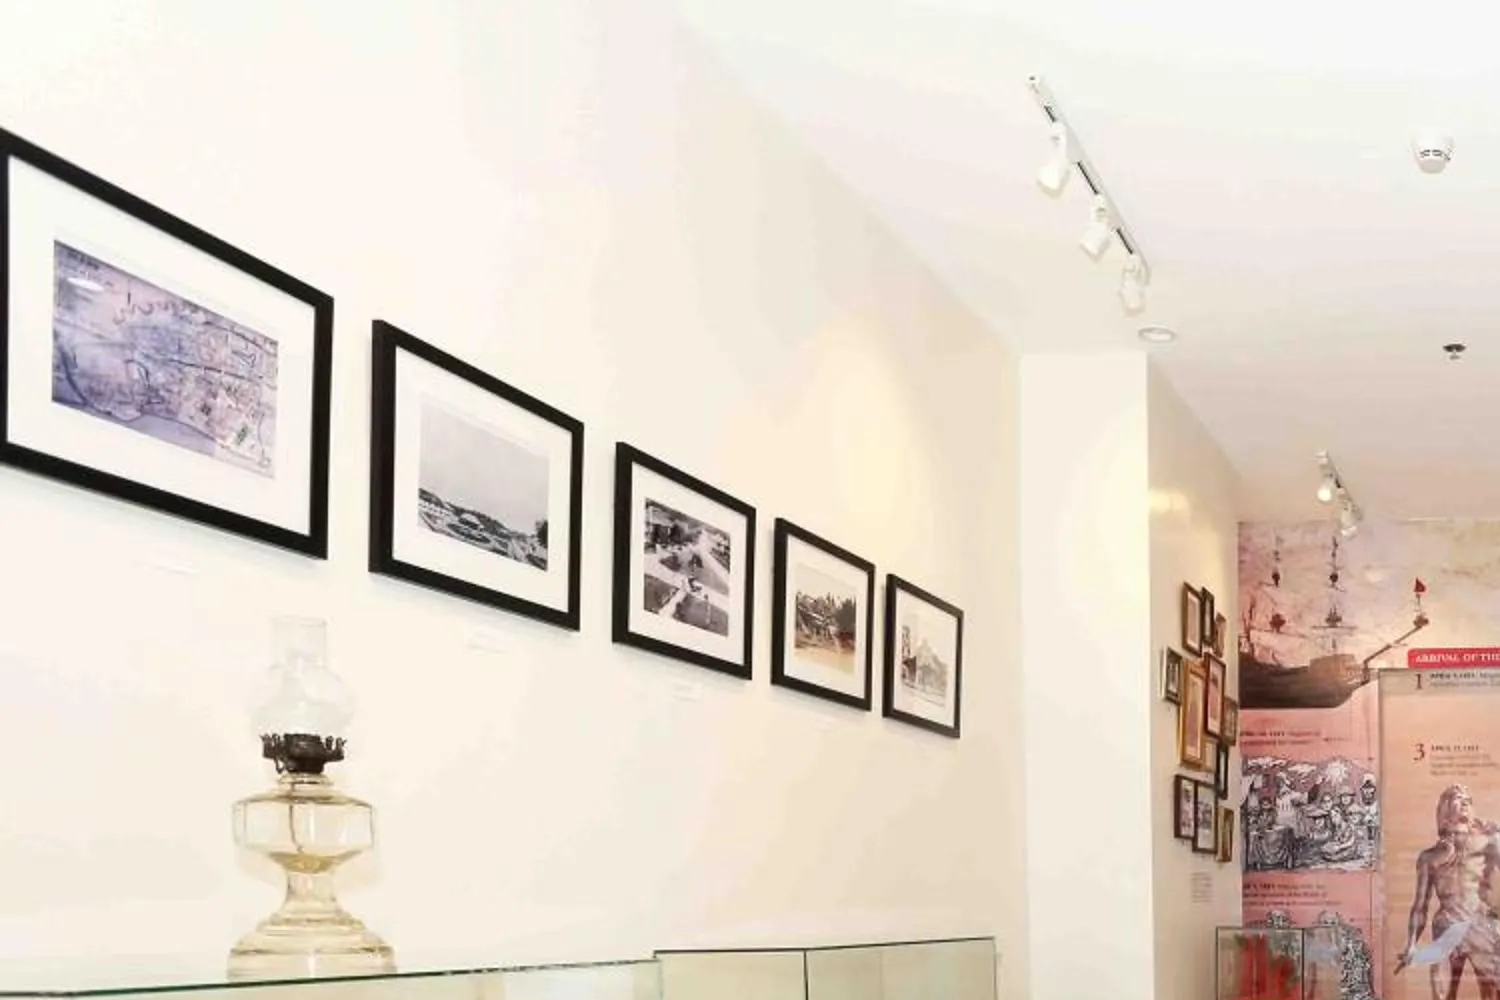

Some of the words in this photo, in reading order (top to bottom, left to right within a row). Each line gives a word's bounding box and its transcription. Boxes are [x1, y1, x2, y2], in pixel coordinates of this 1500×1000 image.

[1415, 653, 1460, 664] ARRIVAL
[1463, 652, 1476, 662] OF
[1414, 673, 1423, 690] 1
[1413, 743, 1425, 761] 3
